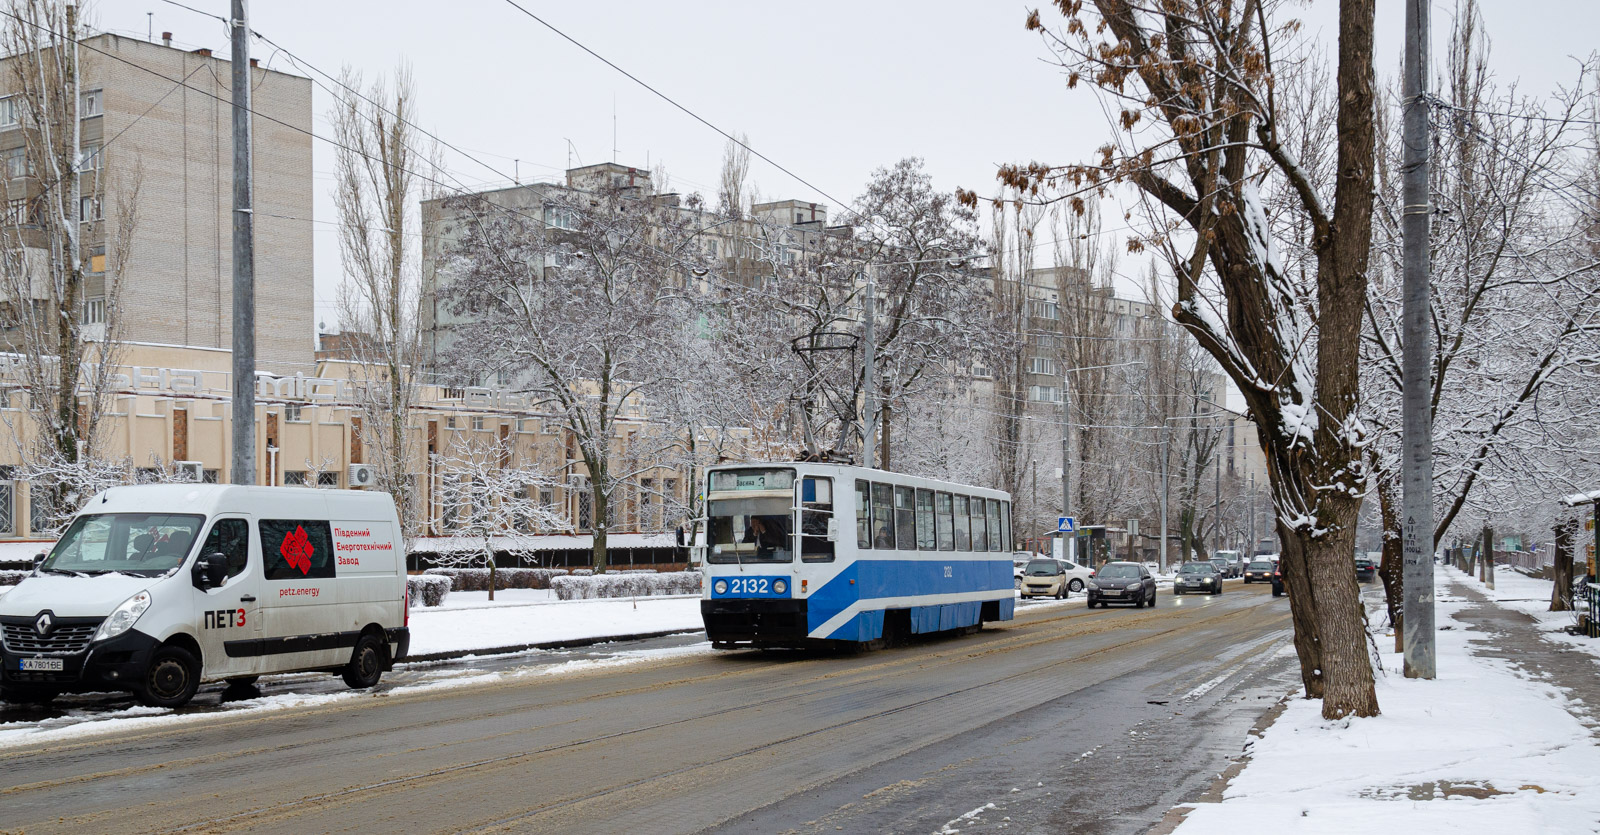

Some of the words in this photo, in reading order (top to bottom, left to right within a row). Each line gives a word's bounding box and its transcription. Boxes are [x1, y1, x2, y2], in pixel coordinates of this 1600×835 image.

[334, 527, 371, 538] Південний
[336, 541, 393, 553] Енерготехнічний
[338, 556, 360, 567] Завод
[731, 578, 769, 593] 2132
[279, 586, 320, 599] petz.energy
